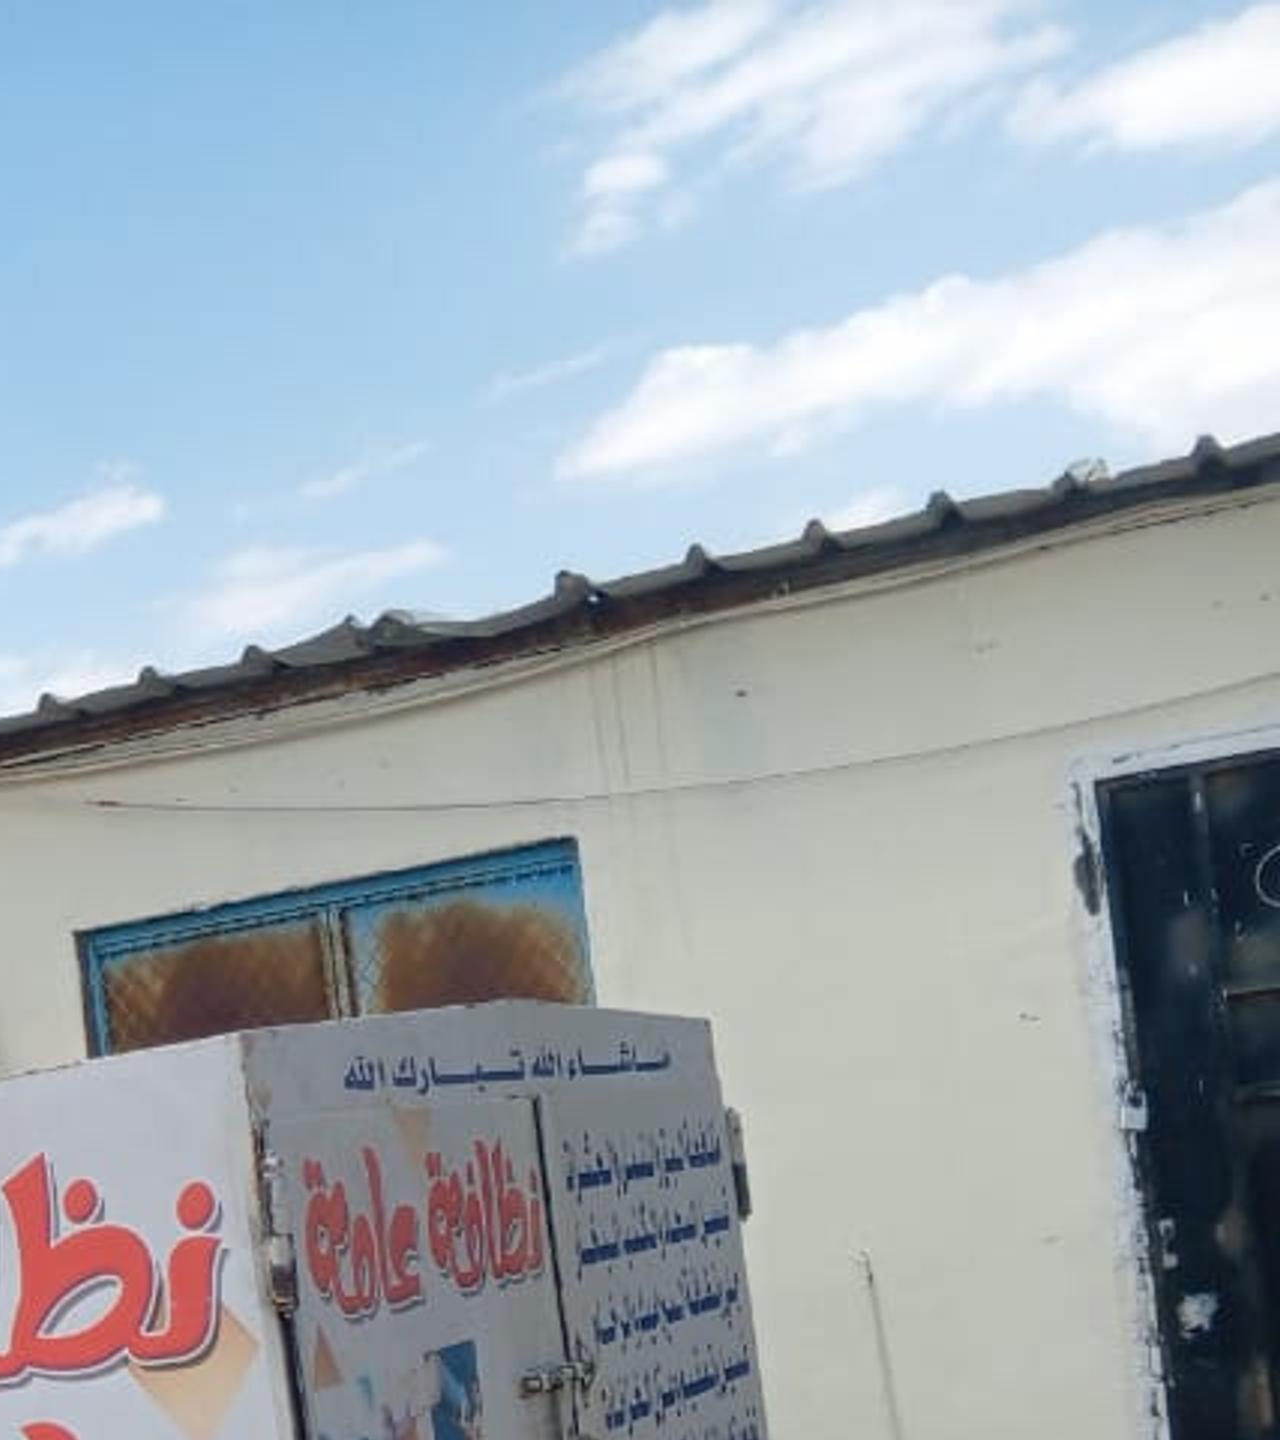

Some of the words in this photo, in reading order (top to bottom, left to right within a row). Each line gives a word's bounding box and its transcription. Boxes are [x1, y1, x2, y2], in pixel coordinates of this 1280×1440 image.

[344, 1055, 385, 1091] الله
[392, 1048, 525, 1094] تبارك
[532, 1044, 563, 1078] الله
[302, 1145, 424, 1320] عامة
[425, 1137, 545, 1294] نظافة
